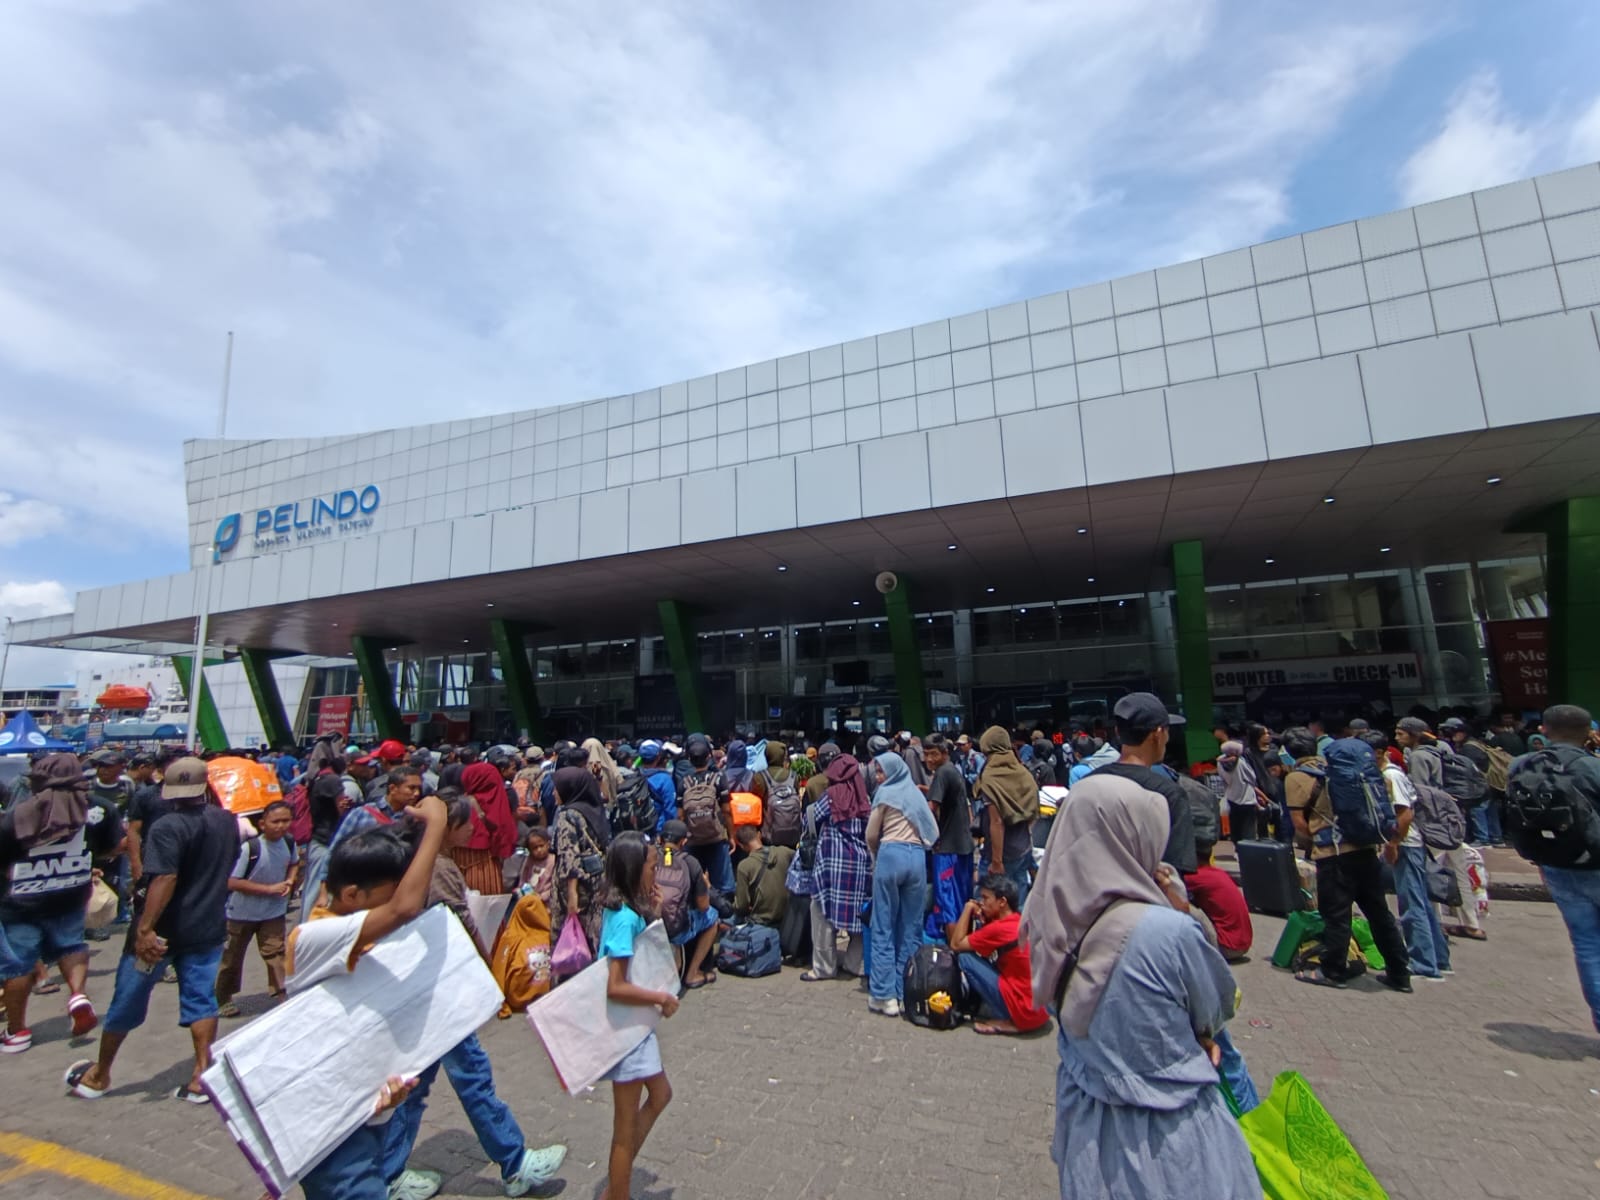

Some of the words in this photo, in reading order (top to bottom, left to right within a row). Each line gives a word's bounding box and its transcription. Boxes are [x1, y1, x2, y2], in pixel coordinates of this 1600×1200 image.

[256, 485, 380, 536] PELINDO
[1214, 669, 1286, 687] COUNTER
[1333, 663, 1417, 682] CHECK-IN
